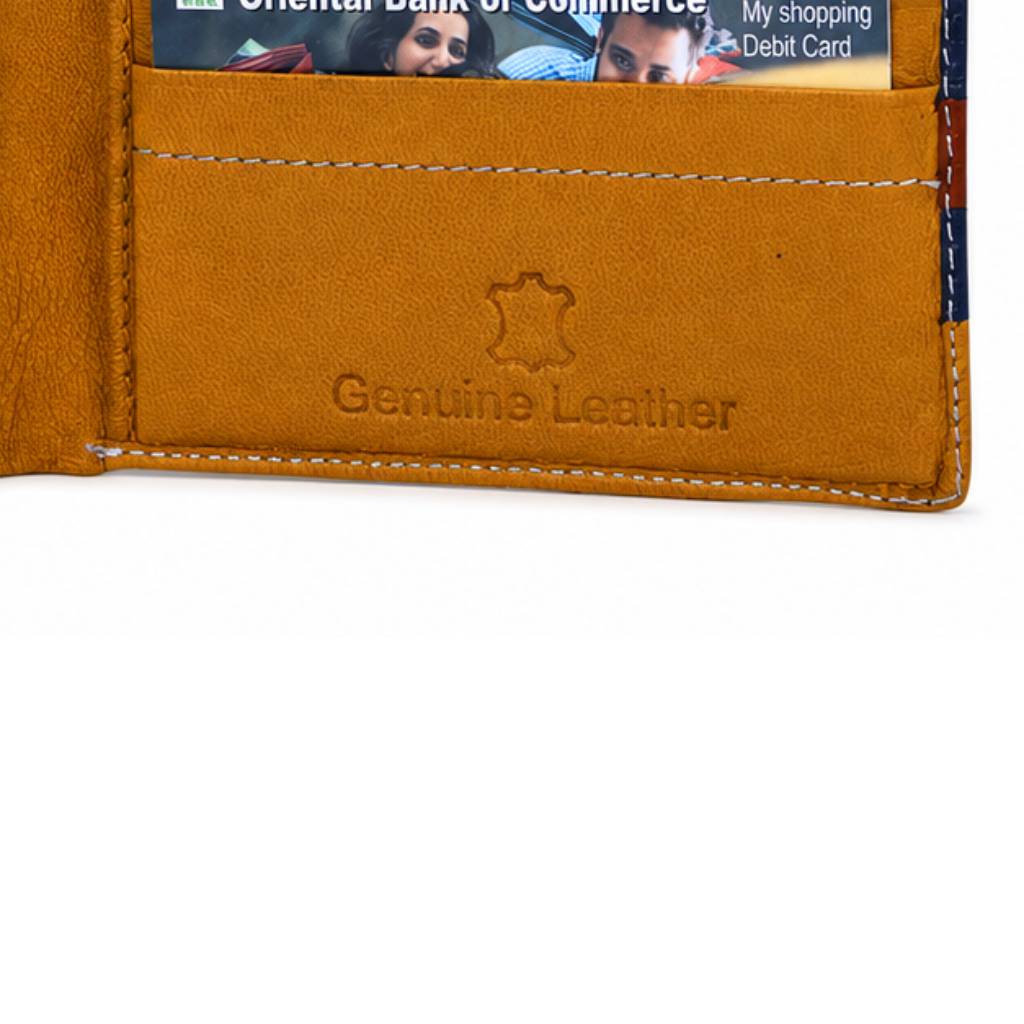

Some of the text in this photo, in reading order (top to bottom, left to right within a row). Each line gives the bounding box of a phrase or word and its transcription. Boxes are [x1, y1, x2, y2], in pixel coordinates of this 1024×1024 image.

[742, 0, 873, 29] My shopping
[743, 33, 852, 59] Debit Card
[332, 373, 739, 433] Genuine Leather
